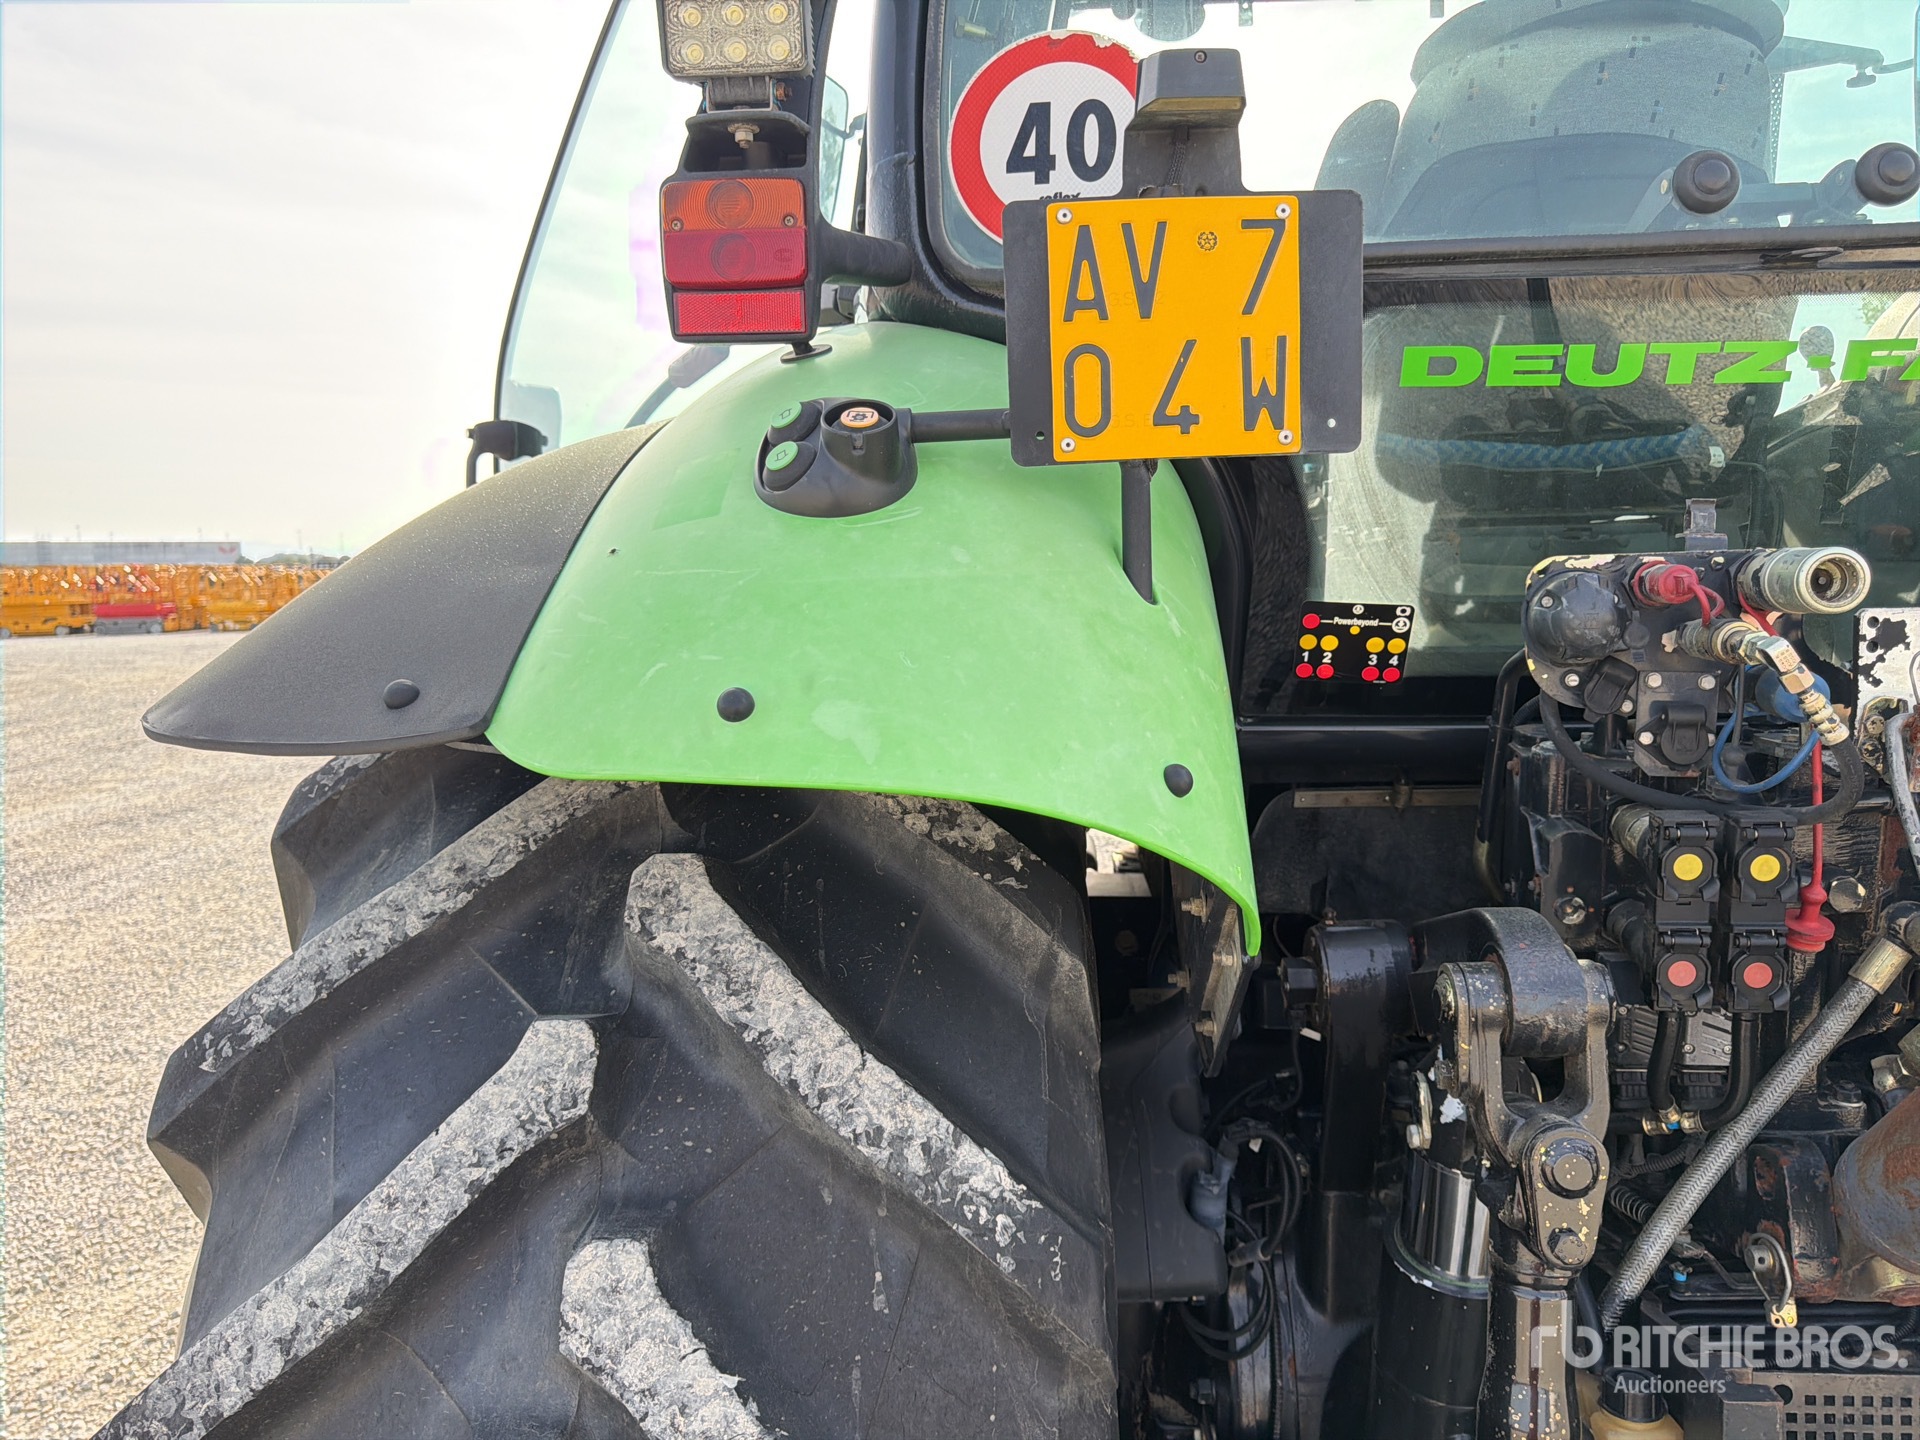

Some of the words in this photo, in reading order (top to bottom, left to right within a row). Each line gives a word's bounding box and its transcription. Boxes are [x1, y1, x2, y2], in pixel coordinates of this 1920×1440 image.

[1006, 98, 1117, 185] 40
[1063, 221, 1168, 322] AV
[1400, 339, 1920, 387] DEUTZ-F
[1333, 616, 1379, 628] Powerbeyond
[1302, 651, 1310, 662] 1
[1322, 652, 1332, 663] 2
[1368, 654, 1378, 665] 3
[1388, 654, 1399, 666] 4
